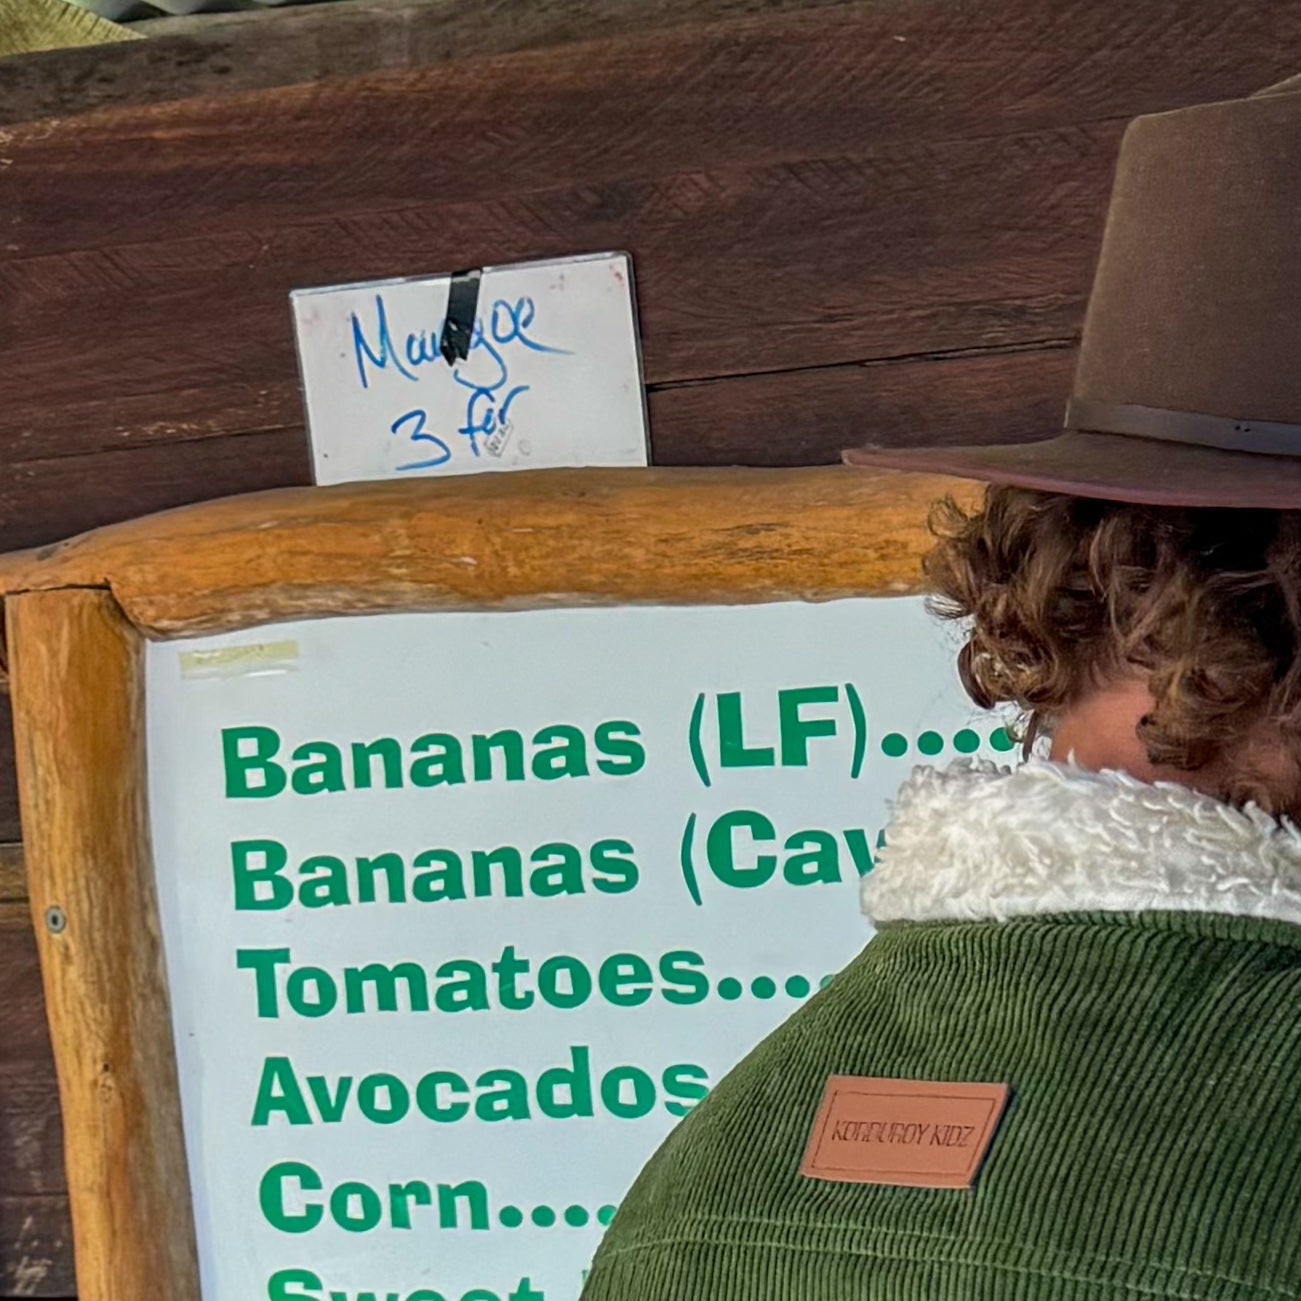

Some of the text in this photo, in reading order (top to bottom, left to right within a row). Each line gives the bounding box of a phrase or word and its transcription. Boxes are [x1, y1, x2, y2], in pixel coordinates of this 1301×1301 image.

[390, 408, 451, 470] 3
[220, 719, 647, 800] Bananas
[229, 838, 640, 912] Bananas
[250, 1046, 710, 1127] Avocados
